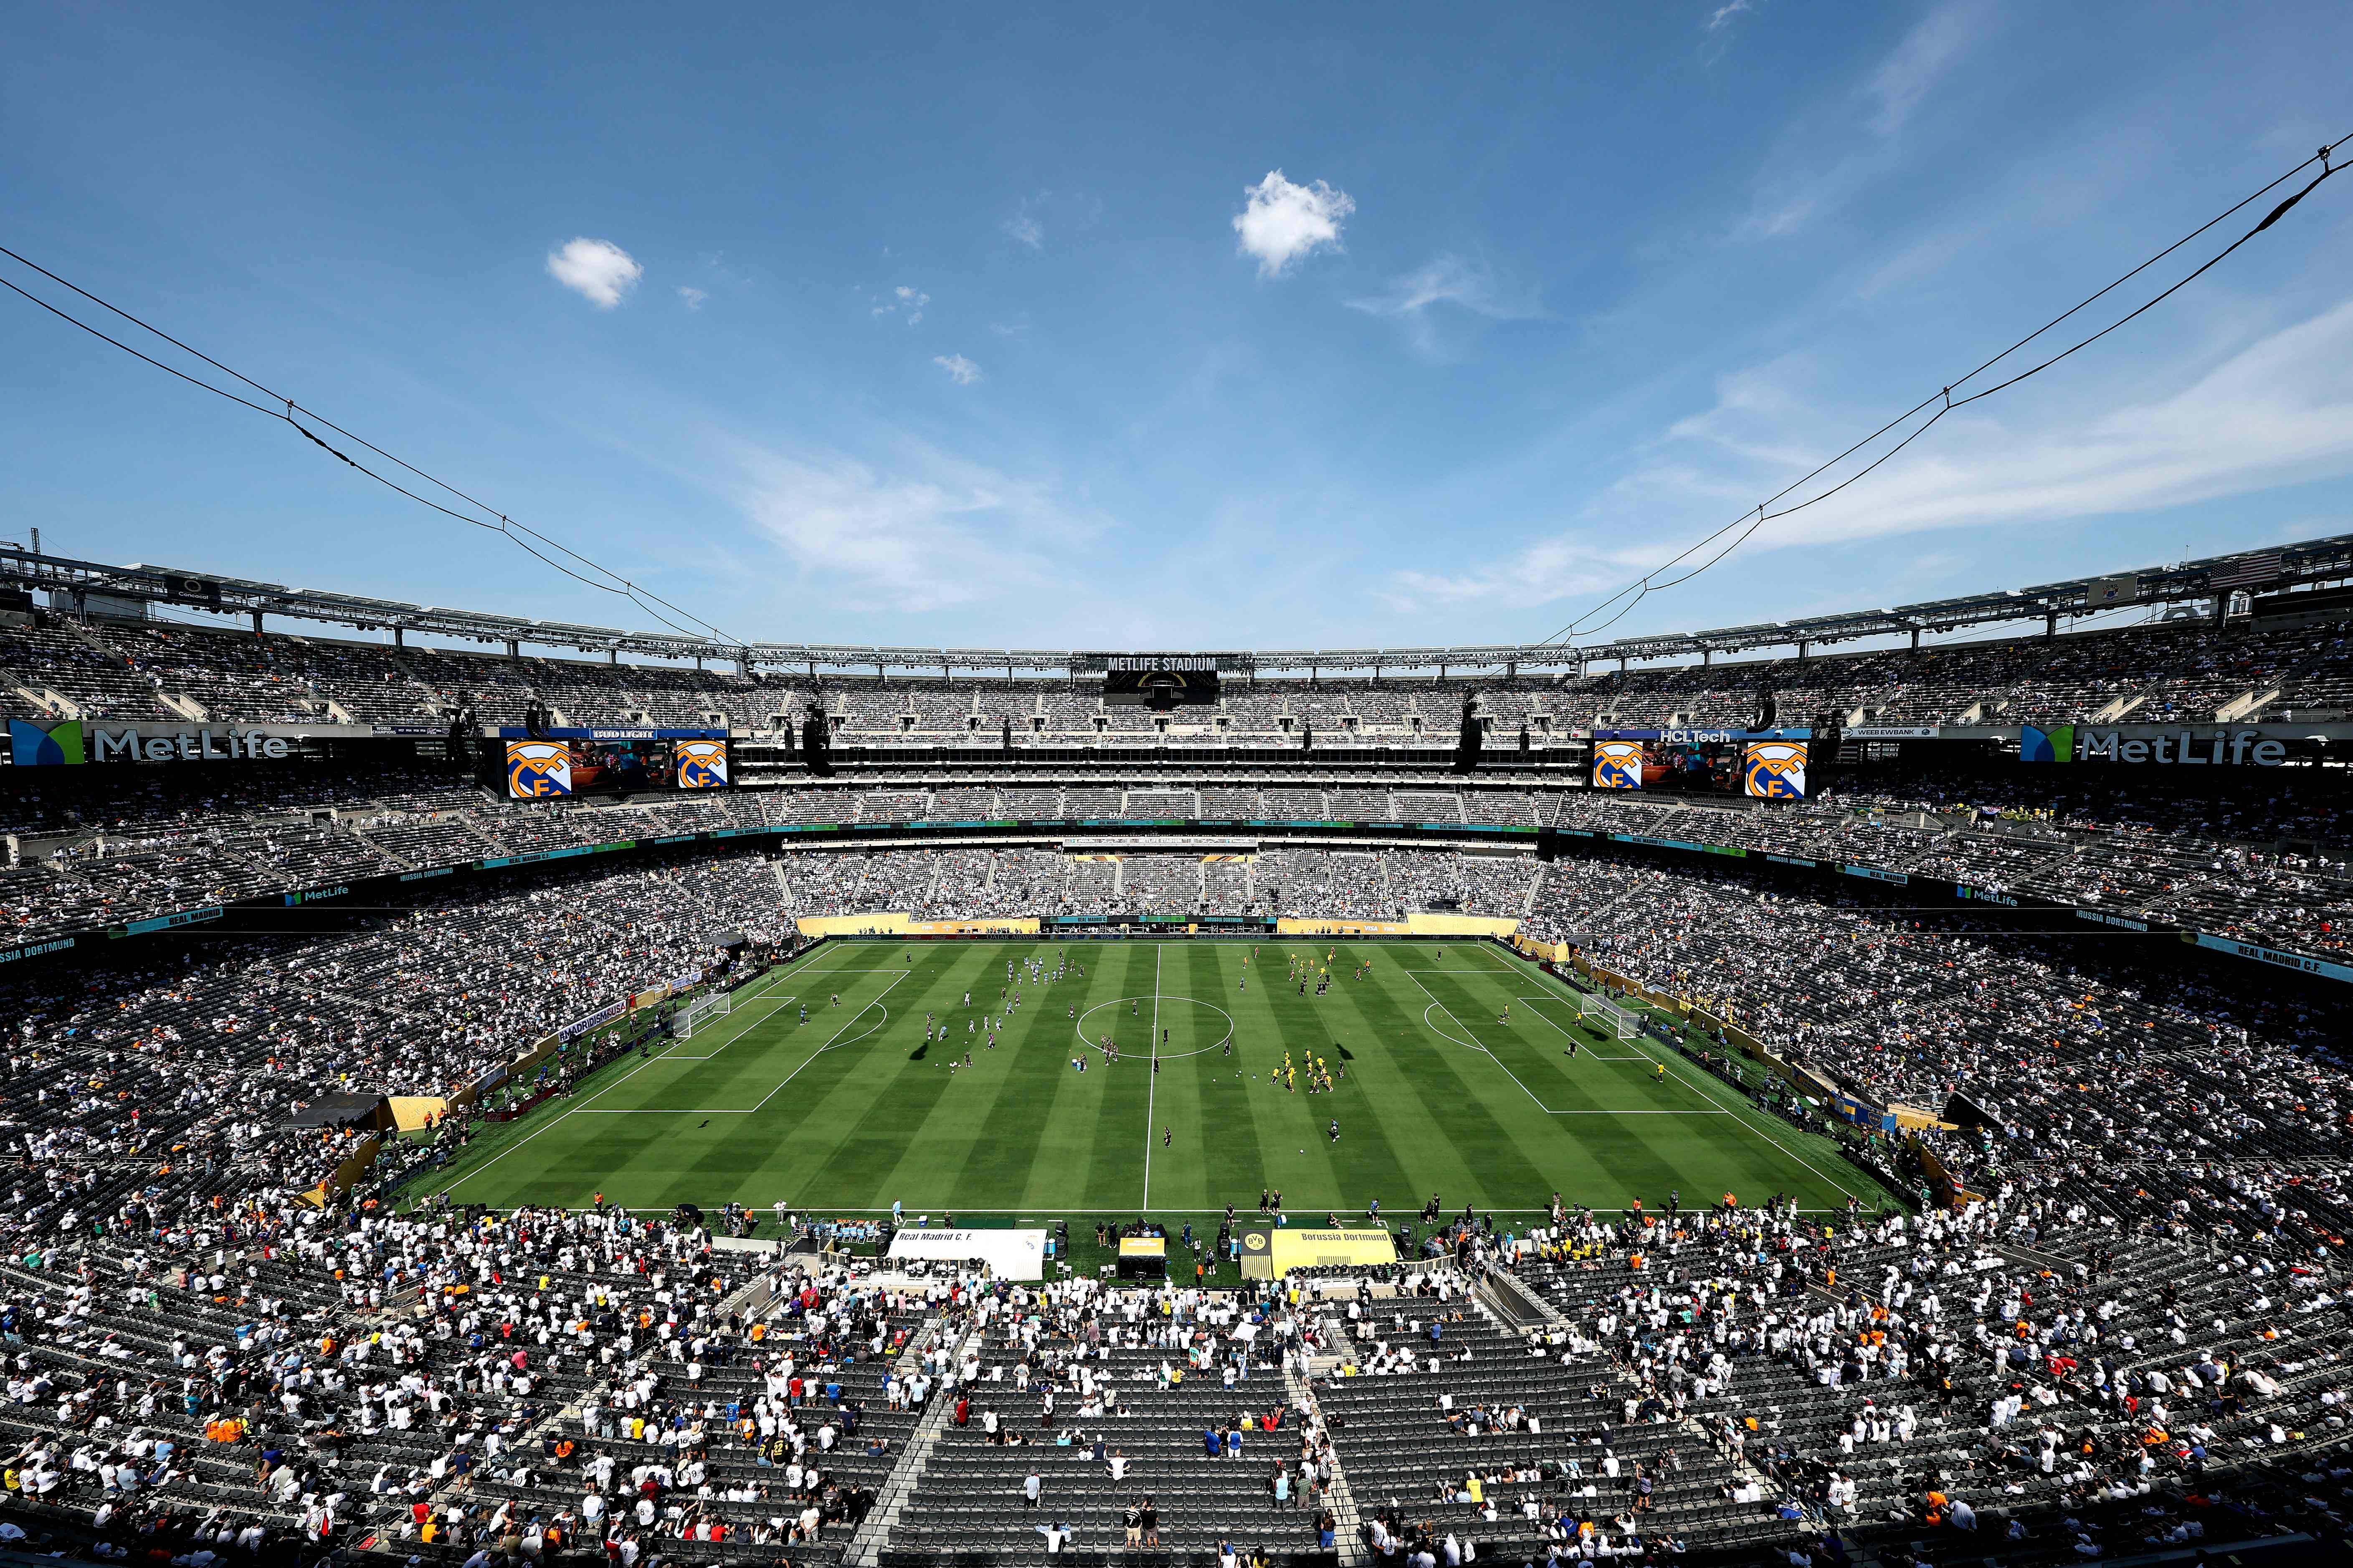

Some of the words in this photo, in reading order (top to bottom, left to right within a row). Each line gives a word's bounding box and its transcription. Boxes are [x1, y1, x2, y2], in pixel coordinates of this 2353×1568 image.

[1108, 658, 1159, 671] METLIFE
[1163, 658, 1216, 671] STADIUM
[1660, 730, 1730, 743] HCLTech
[94, 729, 288, 761] MetLife
[2081, 731, 2285, 766] MetLife
[509, 856, 521, 864] REAL
[522, 854, 541, 862] MADRID
[1766, 855, 1788, 863] BORUSSIA
[1790, 858, 1816, 867] DORTMUND
[424, 867, 453, 878] DORTMUND
[1884, 873, 1905, 883] MADRID
[305, 886, 349, 901] MetLife
[1974, 890, 2018, 906] MetLife
[169, 914, 189, 926] REAL
[190, 908, 220, 921] MADRID
[2106, 916, 2147, 931] DORTMUND
[25, 938, 75, 957] DORTMUND
[2238, 945, 2260, 958] REAL
[2263, 951, 2300, 968] MADRID
[2304, 960, 2322, 973] C.F.
[647, 1027, 662, 1039] VISA
[1649, 1029, 1672, 1047] AMERICA
[592, 1050, 623, 1072] AIRWAYS
[1712, 1067, 1735, 1087] ULTRA
[523, 1095, 545, 1112] Coca-Cola
[1859, 1103, 1875, 1113] VILLA
[353, 1109, 367, 1122] METLIFE
[366, 1101, 379, 1114] STADIUM
[1848, 1151, 1861, 1166] PIF
[1893, 1184, 1907, 1199] PIF
[1248, 1235, 1263, 1244] BVB
[1673, 1461, 1682, 1471] 10
[514, 1476, 522, 1485] 10
[1531, 1510, 1537, 1519] 5
